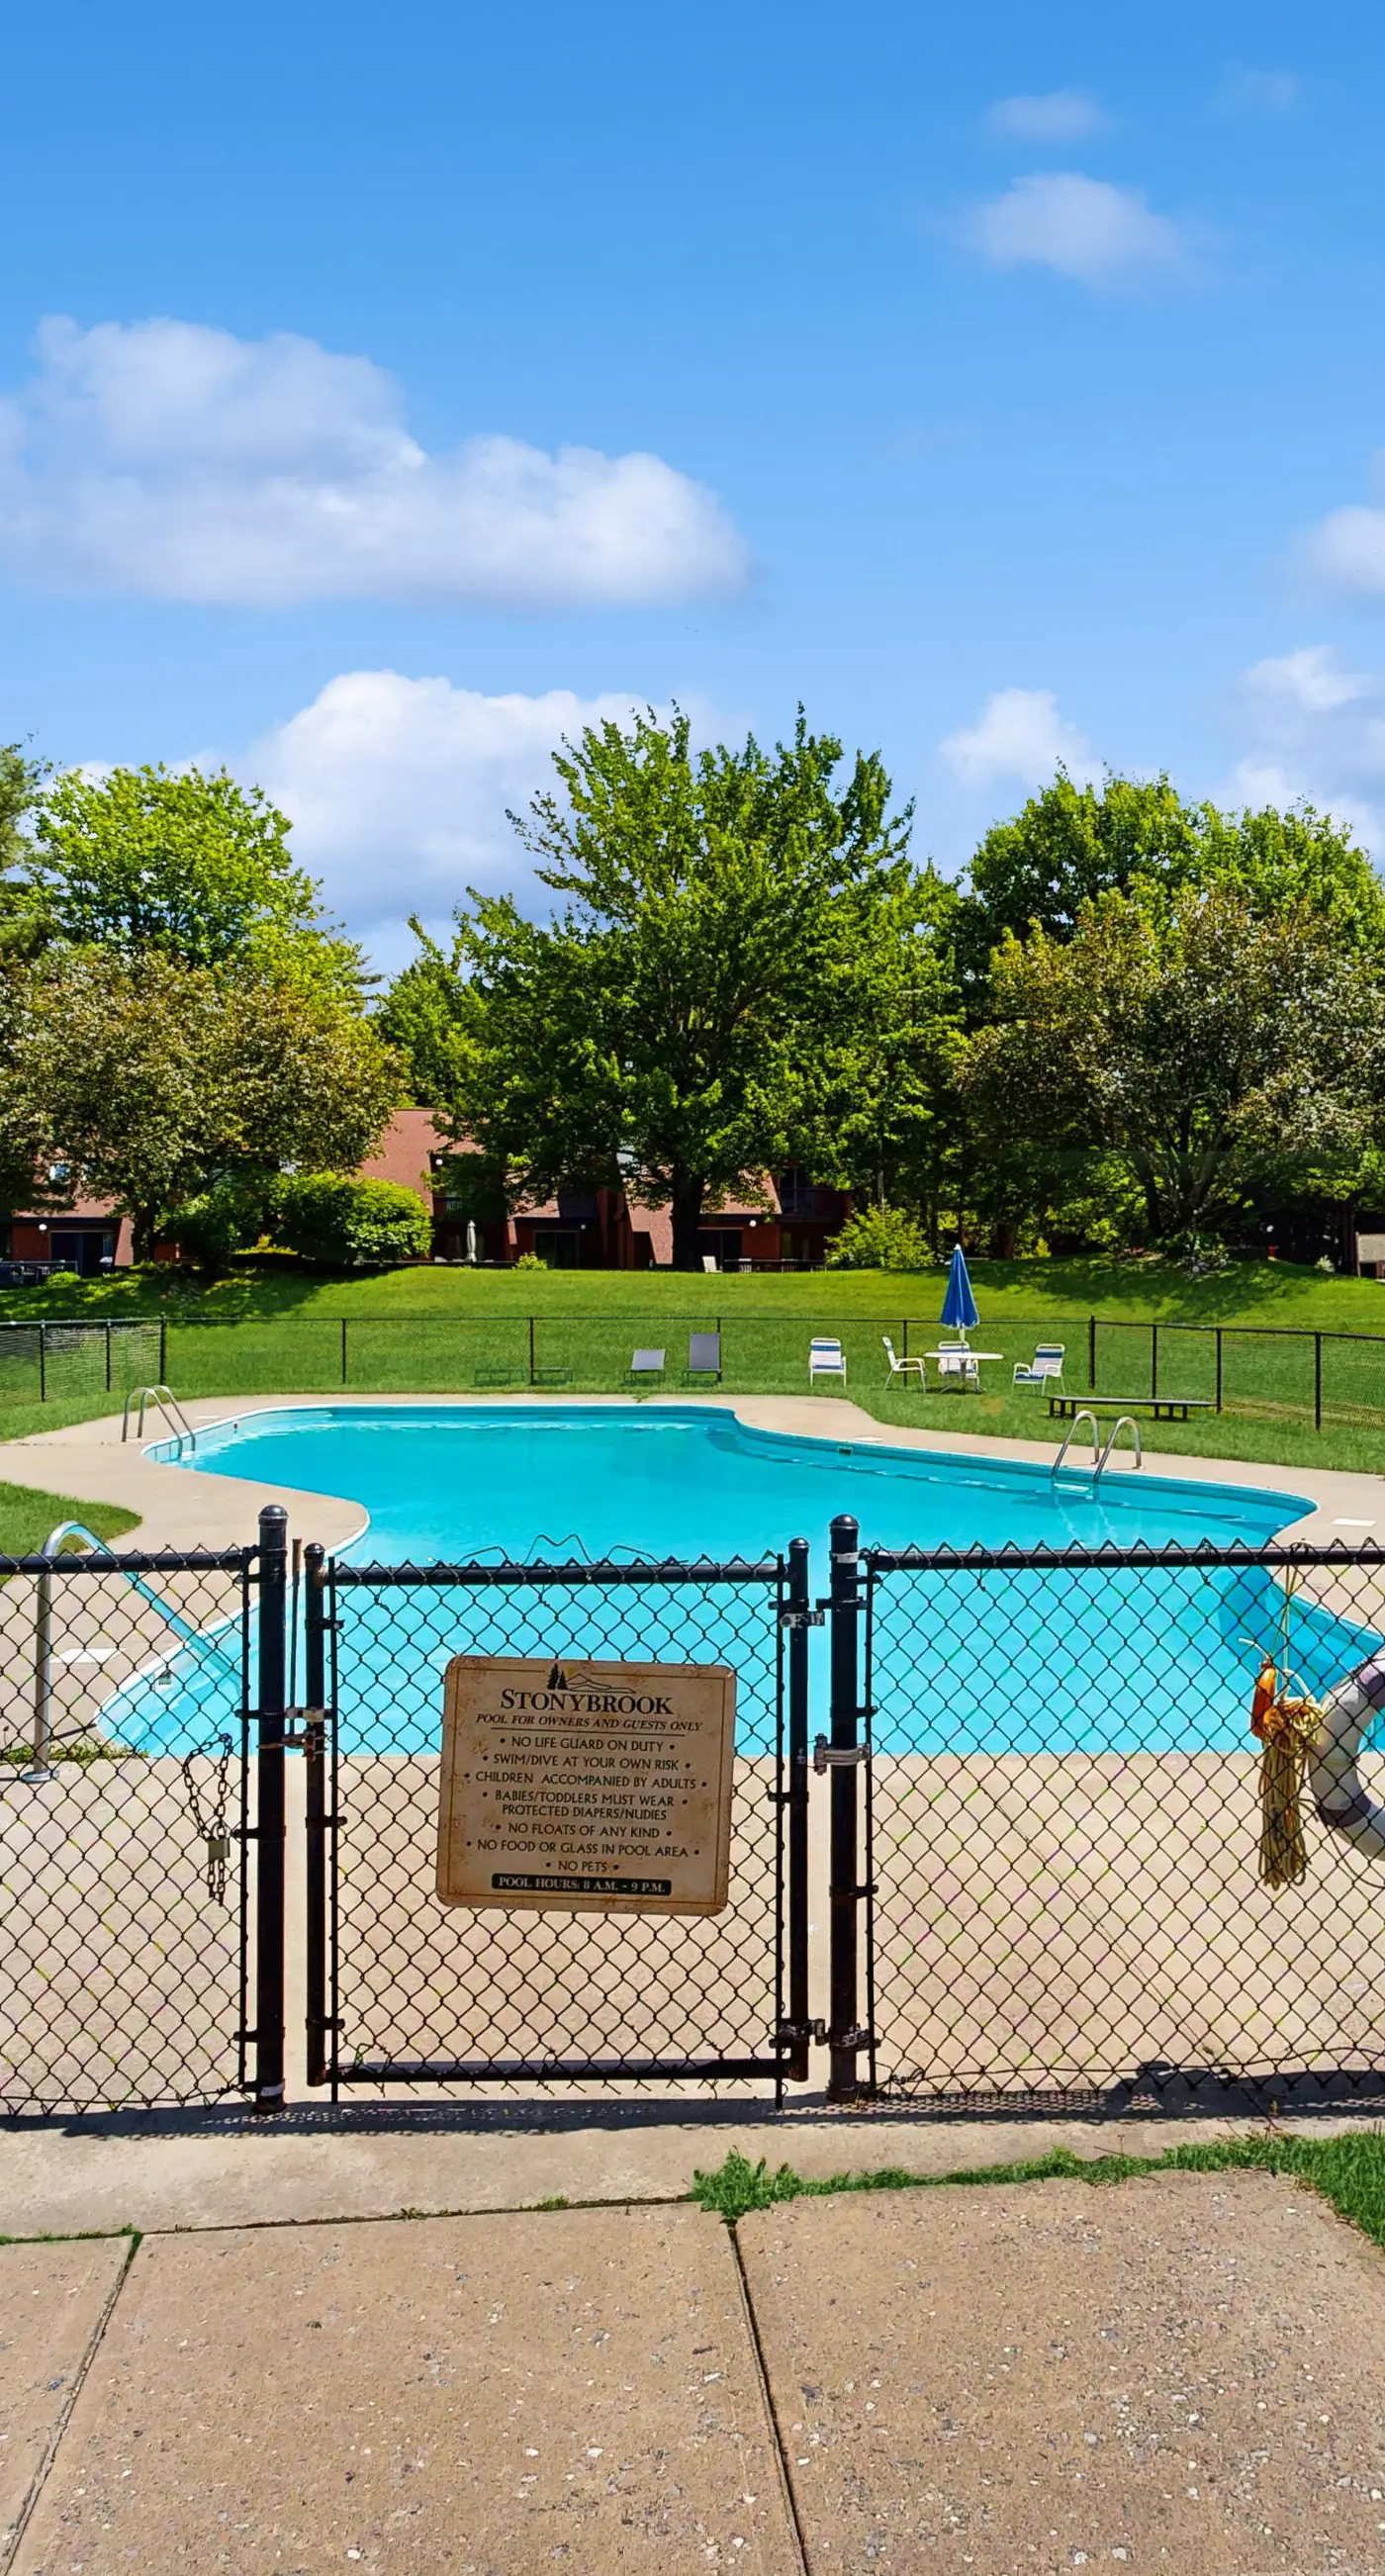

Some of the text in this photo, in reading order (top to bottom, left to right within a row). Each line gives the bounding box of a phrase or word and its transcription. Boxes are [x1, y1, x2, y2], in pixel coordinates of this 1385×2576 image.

[501, 1689, 673, 1714] STONYBROOK
[476, 1713, 703, 1731] POOL FOR OWNERS AND GUESTS ONLY
[511, 1736, 664, 1752] NO LIFE GUARD ON DUTY
[494, 1754, 679, 1770] SWIM/DIVE AT YOUR OWN RISK
[476, 1771, 696, 1789] CHILDREN ACCOMPANIED BY ADULTS
[496, 1791, 674, 1806] BABIES/TODDLERS MUST WEAR
[503, 1805, 667, 1820] PROTECTED DIAPERS/NUDIES
[508, 1823, 660, 1838] NO FLOATS OF ANY KIND
[478, 1840, 689, 1858] NO FOOD OR GLASS IN POOL AREA
[558, 1861, 607, 1872] NO PETS
[499, 1877, 531, 1887] POOL
[535, 1879, 580, 1889] HOURS:
[583, 1880, 590, 1889] 8
[594, 1880, 618, 1890] A.M.
[631, 1882, 638, 1891] 9
[641, 1883, 665, 1892] P.M.
